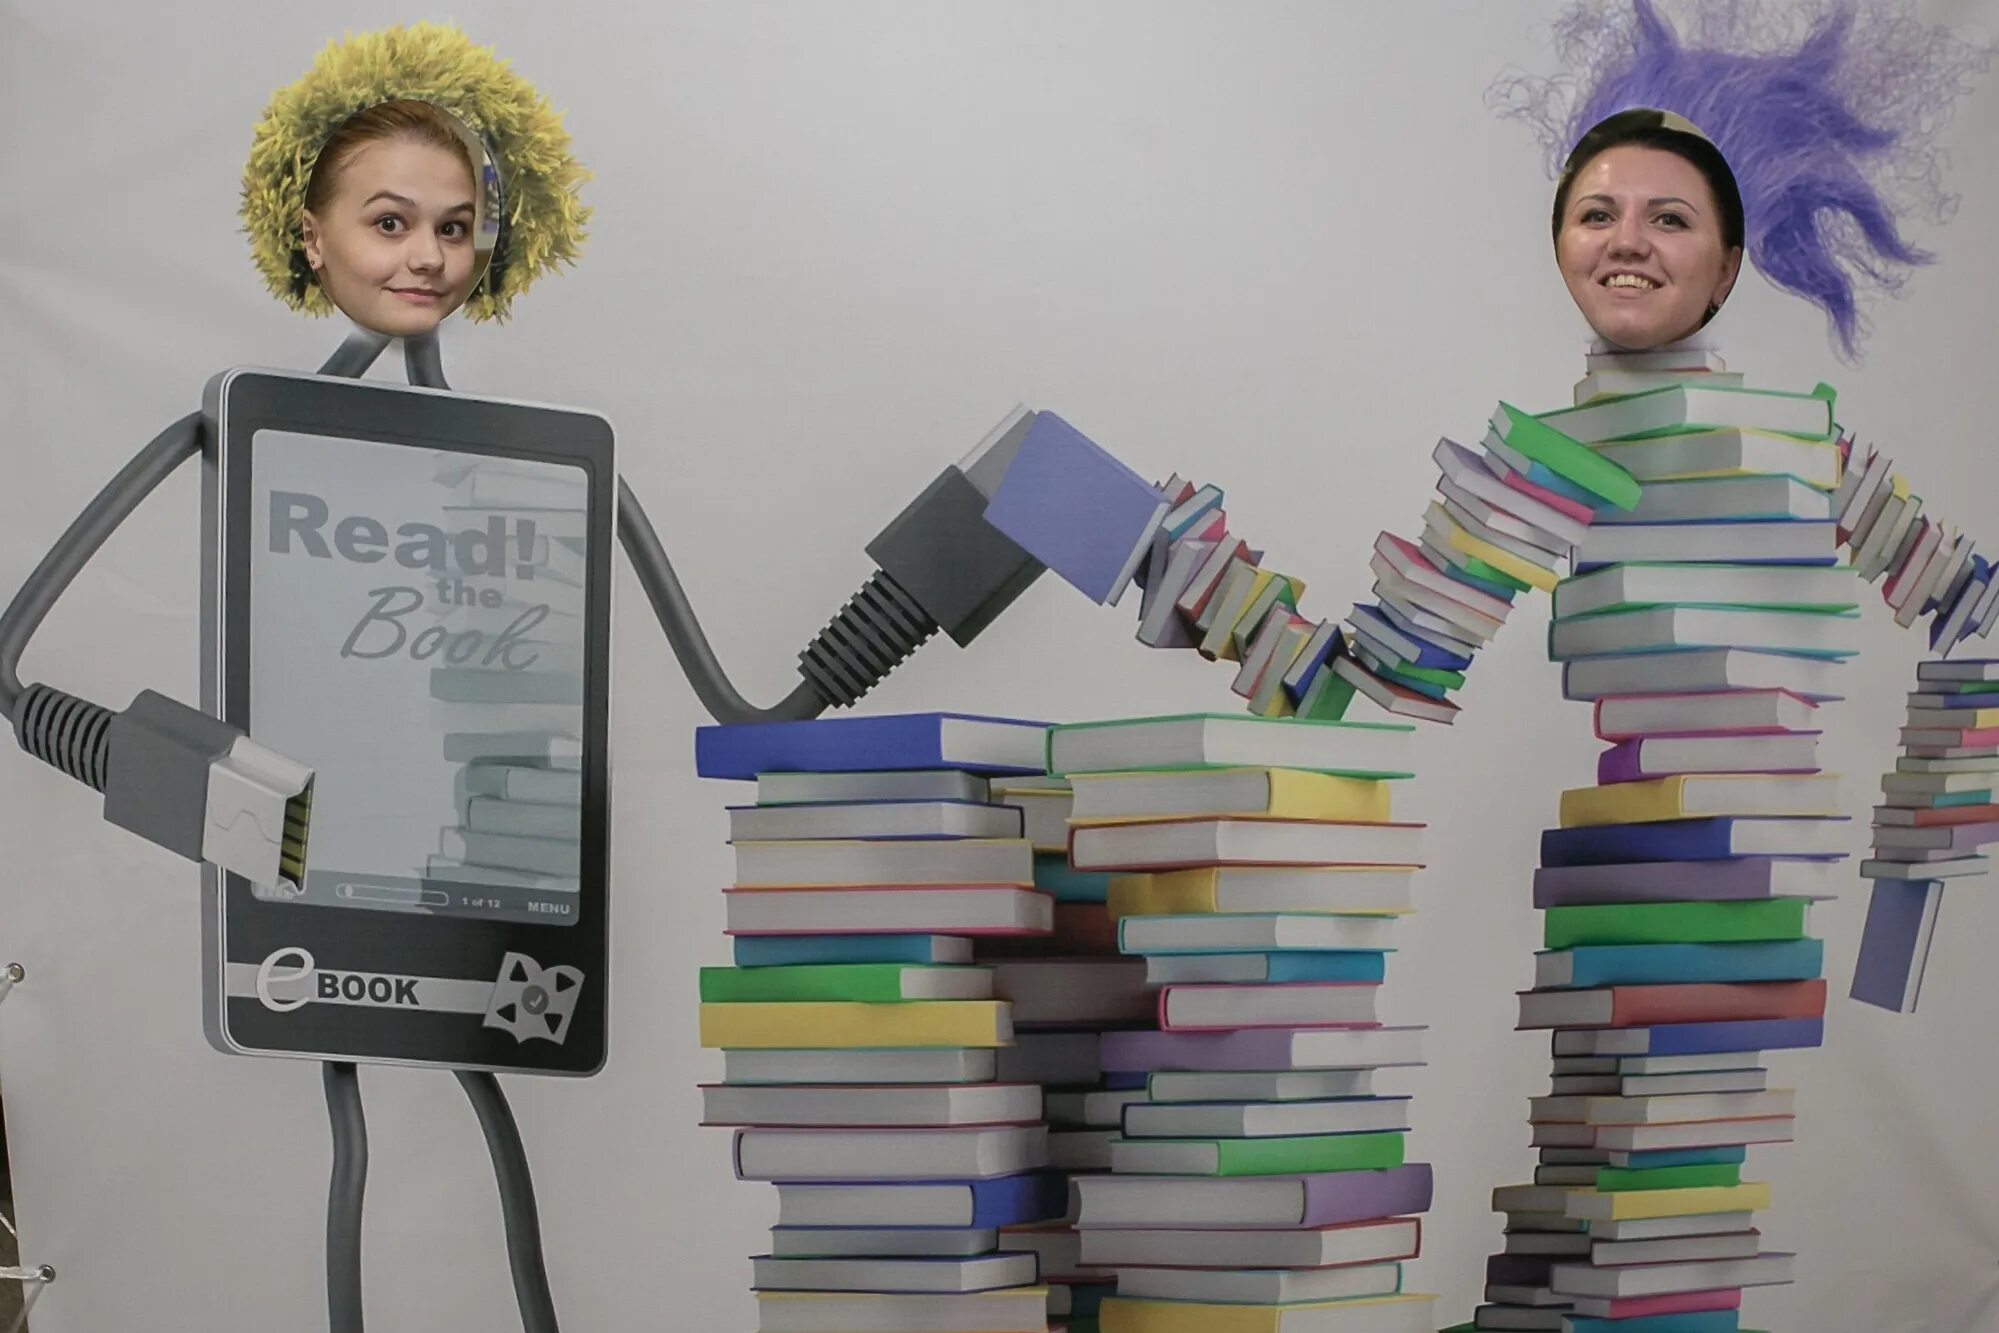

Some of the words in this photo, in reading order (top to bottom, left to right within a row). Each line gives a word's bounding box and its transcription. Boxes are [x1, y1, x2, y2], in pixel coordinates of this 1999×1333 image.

[269, 490, 536, 581] Read!
[435, 578, 503, 609] the
[340, 585, 550, 671] Book
[527, 901, 571, 915] MENU
